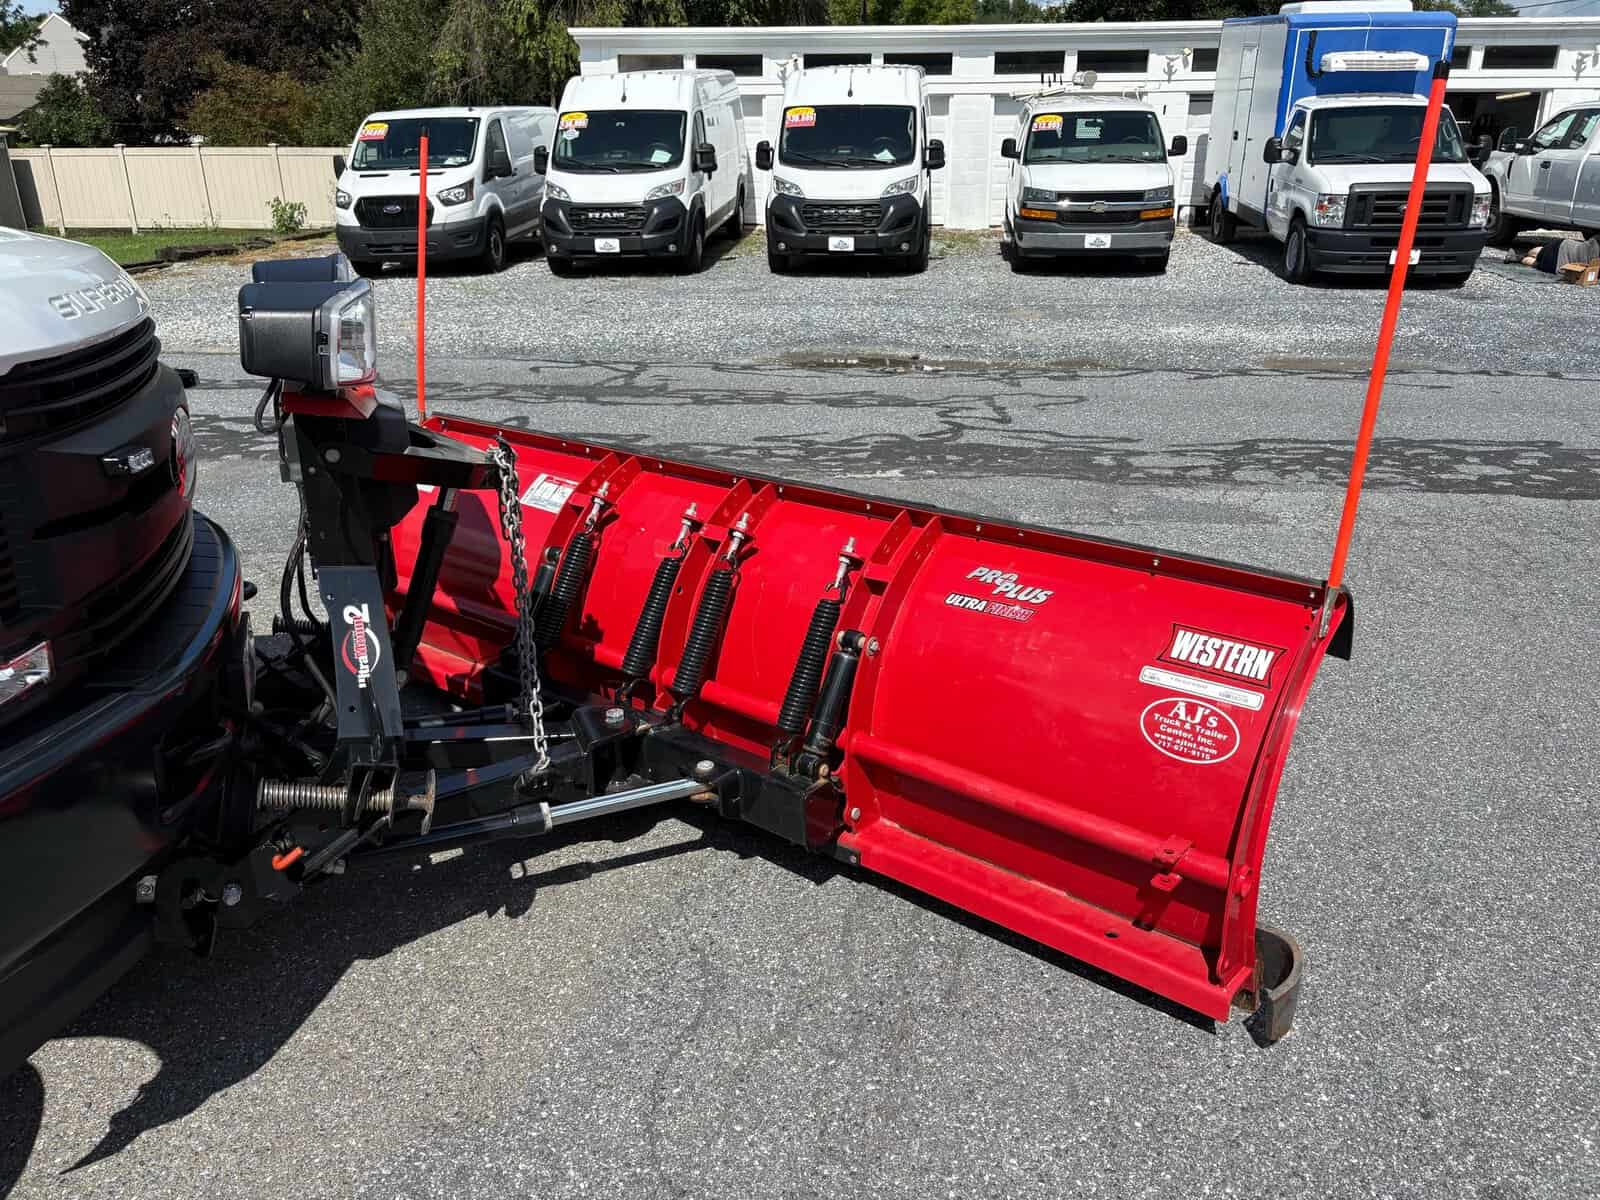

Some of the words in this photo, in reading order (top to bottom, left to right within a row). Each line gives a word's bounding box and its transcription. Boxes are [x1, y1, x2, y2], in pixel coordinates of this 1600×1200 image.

[966, 566, 1018, 585] PRO
[991, 582, 1054, 604] PLUS
[343, 603, 370, 624] 2
[946, 594, 987, 611] ULTRA
[985, 602, 1033, 620] FINISH
[1170, 630, 1275, 680] WESTERN
[1168, 701, 1218, 727] AJ's
[1153, 713, 1181, 727] Truck
[1183, 722, 1192, 730] &
[1195, 725, 1229, 741] Trailer
[1197, 735, 1216, 747] Inc.
